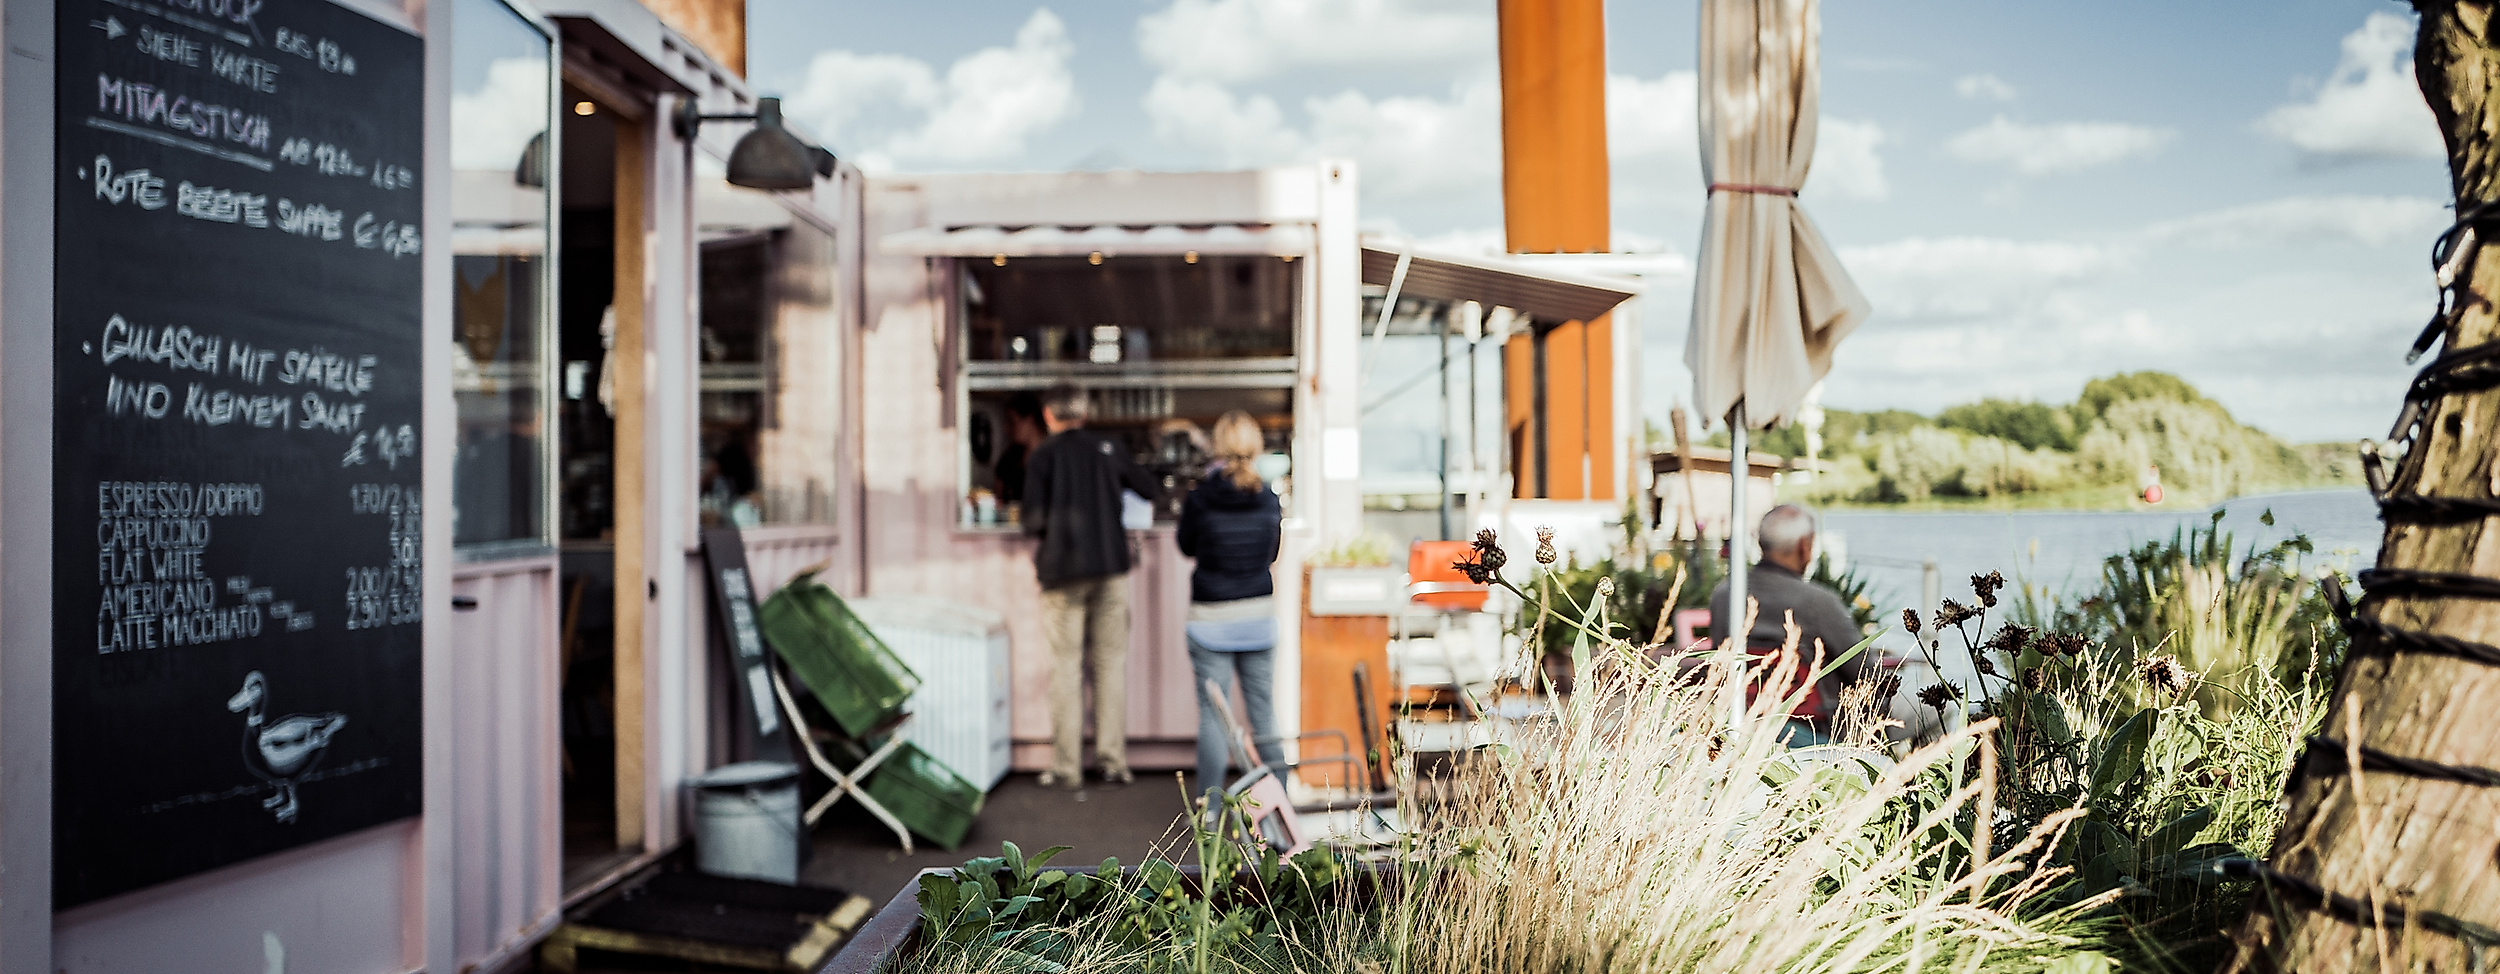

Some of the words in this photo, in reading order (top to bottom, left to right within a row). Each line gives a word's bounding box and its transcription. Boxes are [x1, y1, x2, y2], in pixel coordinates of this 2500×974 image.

[136, 24, 201, 68] SIEHE
[211, 43, 280, 94] KARTE
[98, 72, 270, 151] MITTAGSTISCH
[95, 154, 168, 211] ROTE
[102, 313, 221, 374] GULASCH
[228, 336, 276, 385] MIT
[106, 373, 171, 419] UND
[184, 381, 291, 432] KLEINEM
[300, 392, 366, 434] SALAT
[98, 481, 263, 518] ESPRESSO/DOPPIO
[98, 515, 209, 550] CAPPUCCINO
[98, 548, 144, 585] FLAT
[150, 547, 204, 580] WHITE
[99, 578, 214, 621] AMERICANO
[98, 613, 157, 655] LATTE
[162, 604, 261, 647] MACCHIATO
